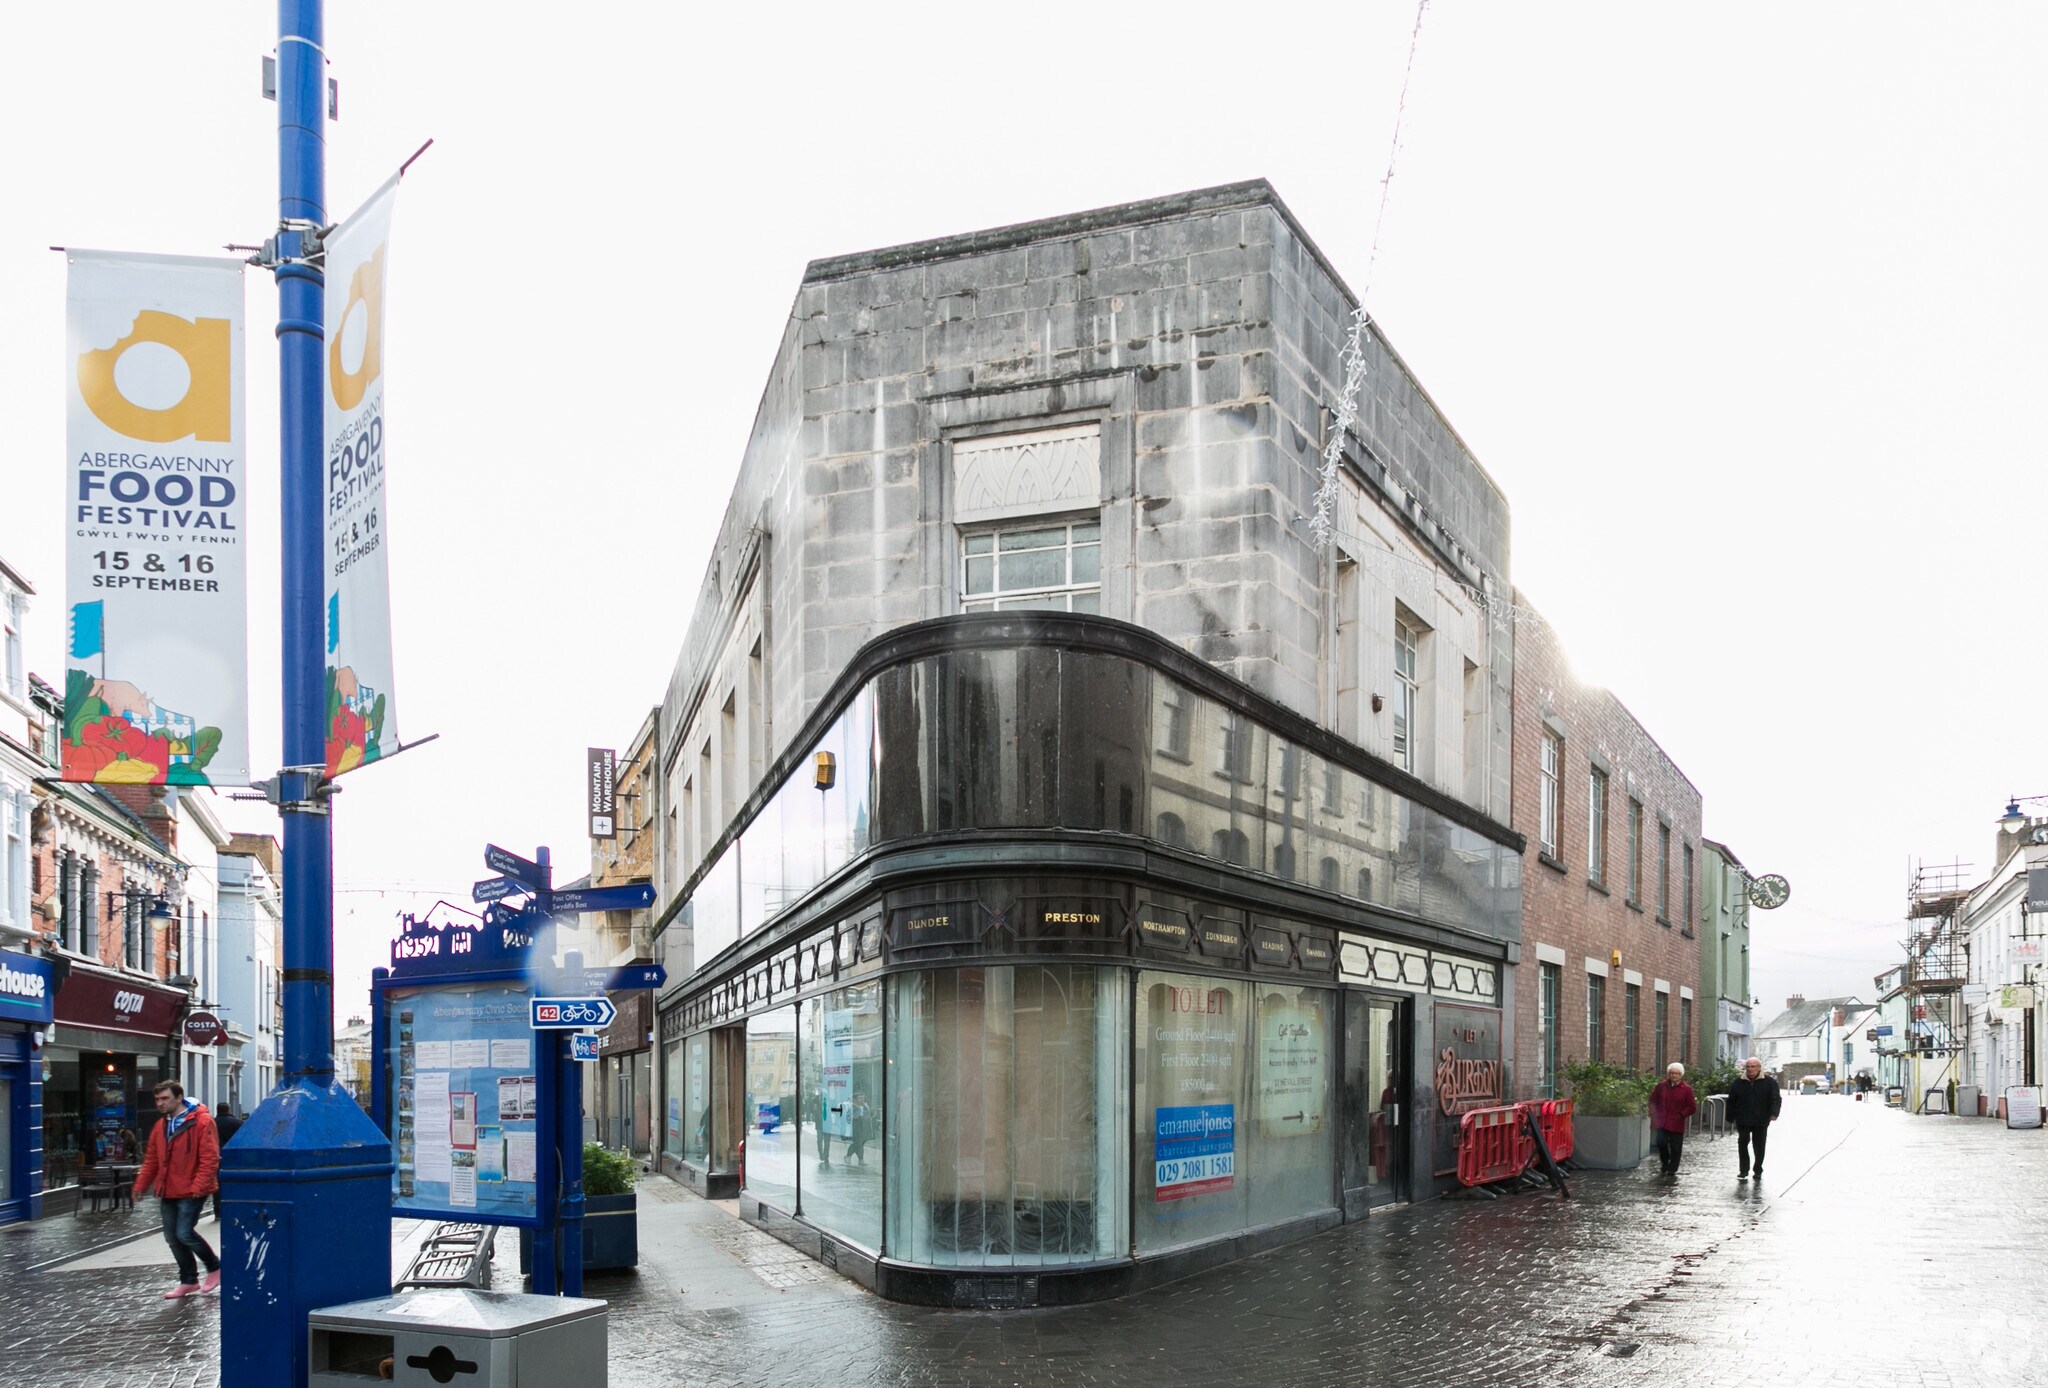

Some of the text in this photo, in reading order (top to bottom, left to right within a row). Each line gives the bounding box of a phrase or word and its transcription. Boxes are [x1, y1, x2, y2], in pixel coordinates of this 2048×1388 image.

[330, 392, 382, 458] ABERGAVENNY
[79, 452, 234, 473] ABERGAVENNY
[330, 415, 382, 494] FOOD
[79, 470, 236, 508] FOOD
[329, 454, 383, 516] FESTIVAL
[78, 505, 236, 530] FESTIVAL
[127, 531, 169, 542] FWYD
[192, 535, 236, 544] FENNI
[334, 507, 377, 557] 15 & 16
[93, 550, 214, 573] 15 & 16
[335, 533, 380, 577] SEPTEMBER
[92, 575, 219, 592] SEPTEMBER
[593, 762, 601, 813] MOUNTAIN
[604, 751, 612, 813] WAREHOUSE
[565, 893, 582, 901] Office
[907, 916, 949, 930] DUNDEE
[1045, 912, 1100, 924] PRESTON
[1143, 920, 1186, 937] NORTHAMPTON
[1205, 931, 1238, 945] EDINBURGH
[1261, 940, 1284, 952] READING
[114, 990, 145, 1013] COSTA
[433, 1003, 529, 1019] Abergavenny Civic Socie
[1168, 987, 1226, 1015] TO LET
[541, 1008, 557, 1018] 42
[187, 1021, 217, 1029] COSTA
[1155, 1026, 1184, 1041] Ground
[1186, 1027, 1205, 1042] Floor
[1161, 1052, 1178, 1067] First
[1179, 1053, 1199, 1067] Floor
[1436, 1046, 1498, 1116] BURTON
[1159, 1110, 1233, 1138] emanueljones
[1158, 1141, 1233, 1157] chartered surveyors
[1158, 1156, 1233, 1183] 029 2081 1581
